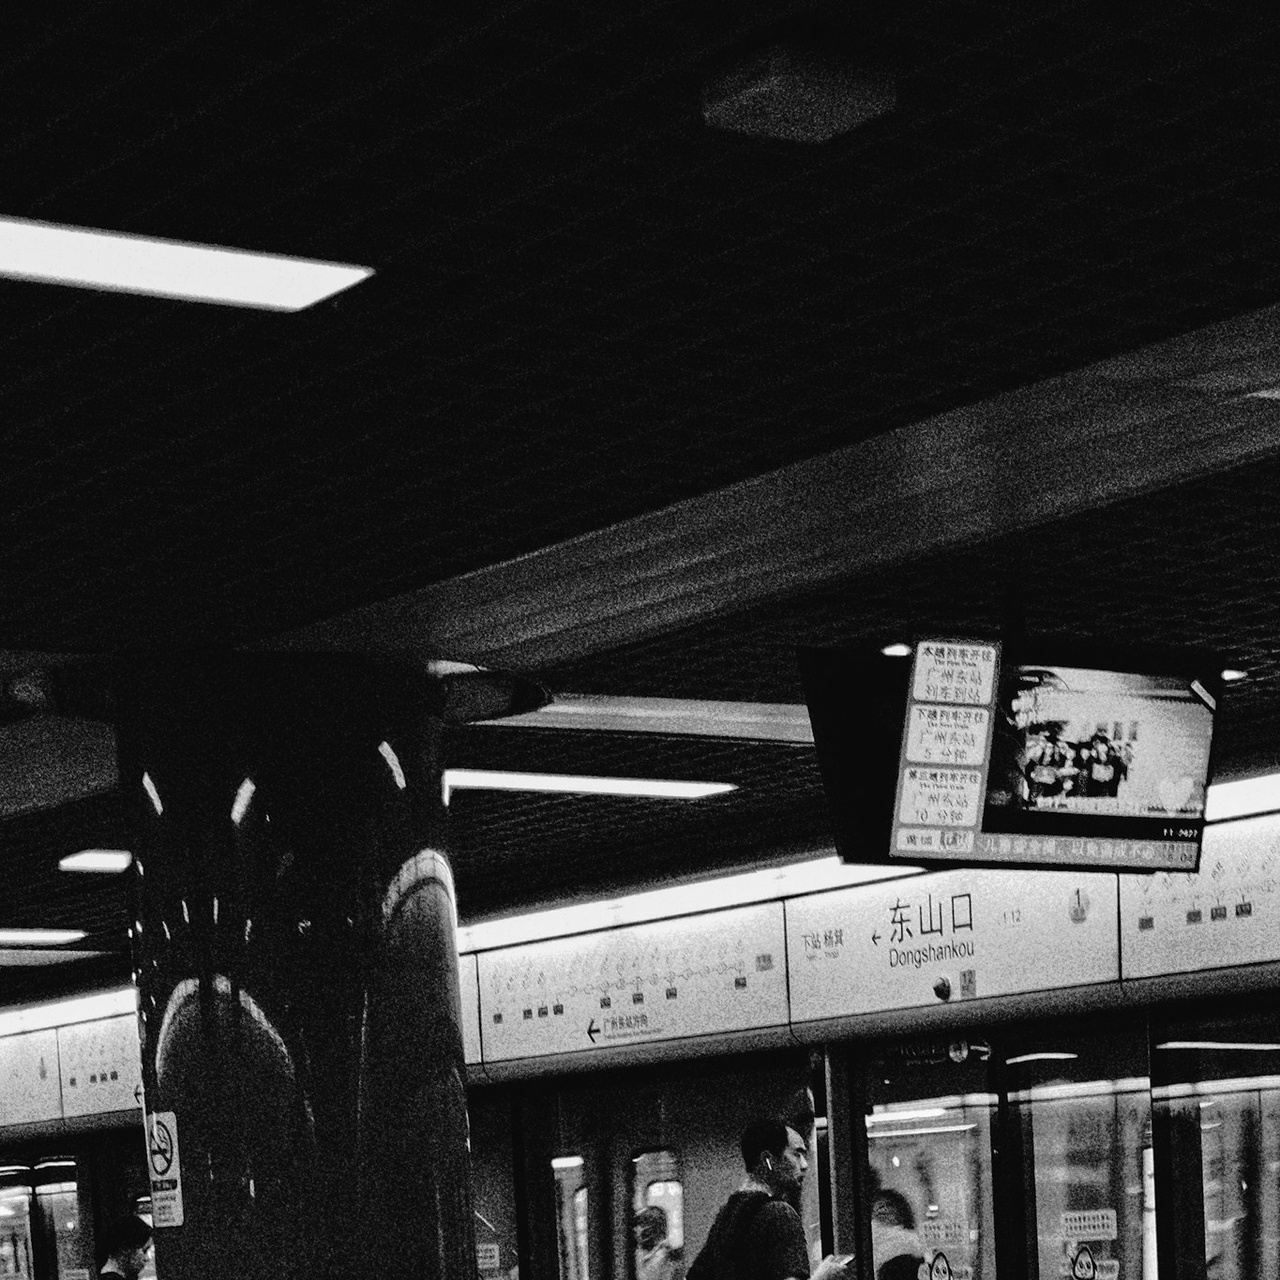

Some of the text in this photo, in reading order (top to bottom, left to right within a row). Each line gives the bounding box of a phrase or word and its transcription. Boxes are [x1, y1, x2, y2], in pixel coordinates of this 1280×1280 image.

[926, 667, 982, 686] 广州东站
[920, 728, 974, 747] 广州东站
[889, 893, 973, 944] 东山口
[801, 932, 822, 952] 下站
[889, 940, 975, 969] Dongshankou
